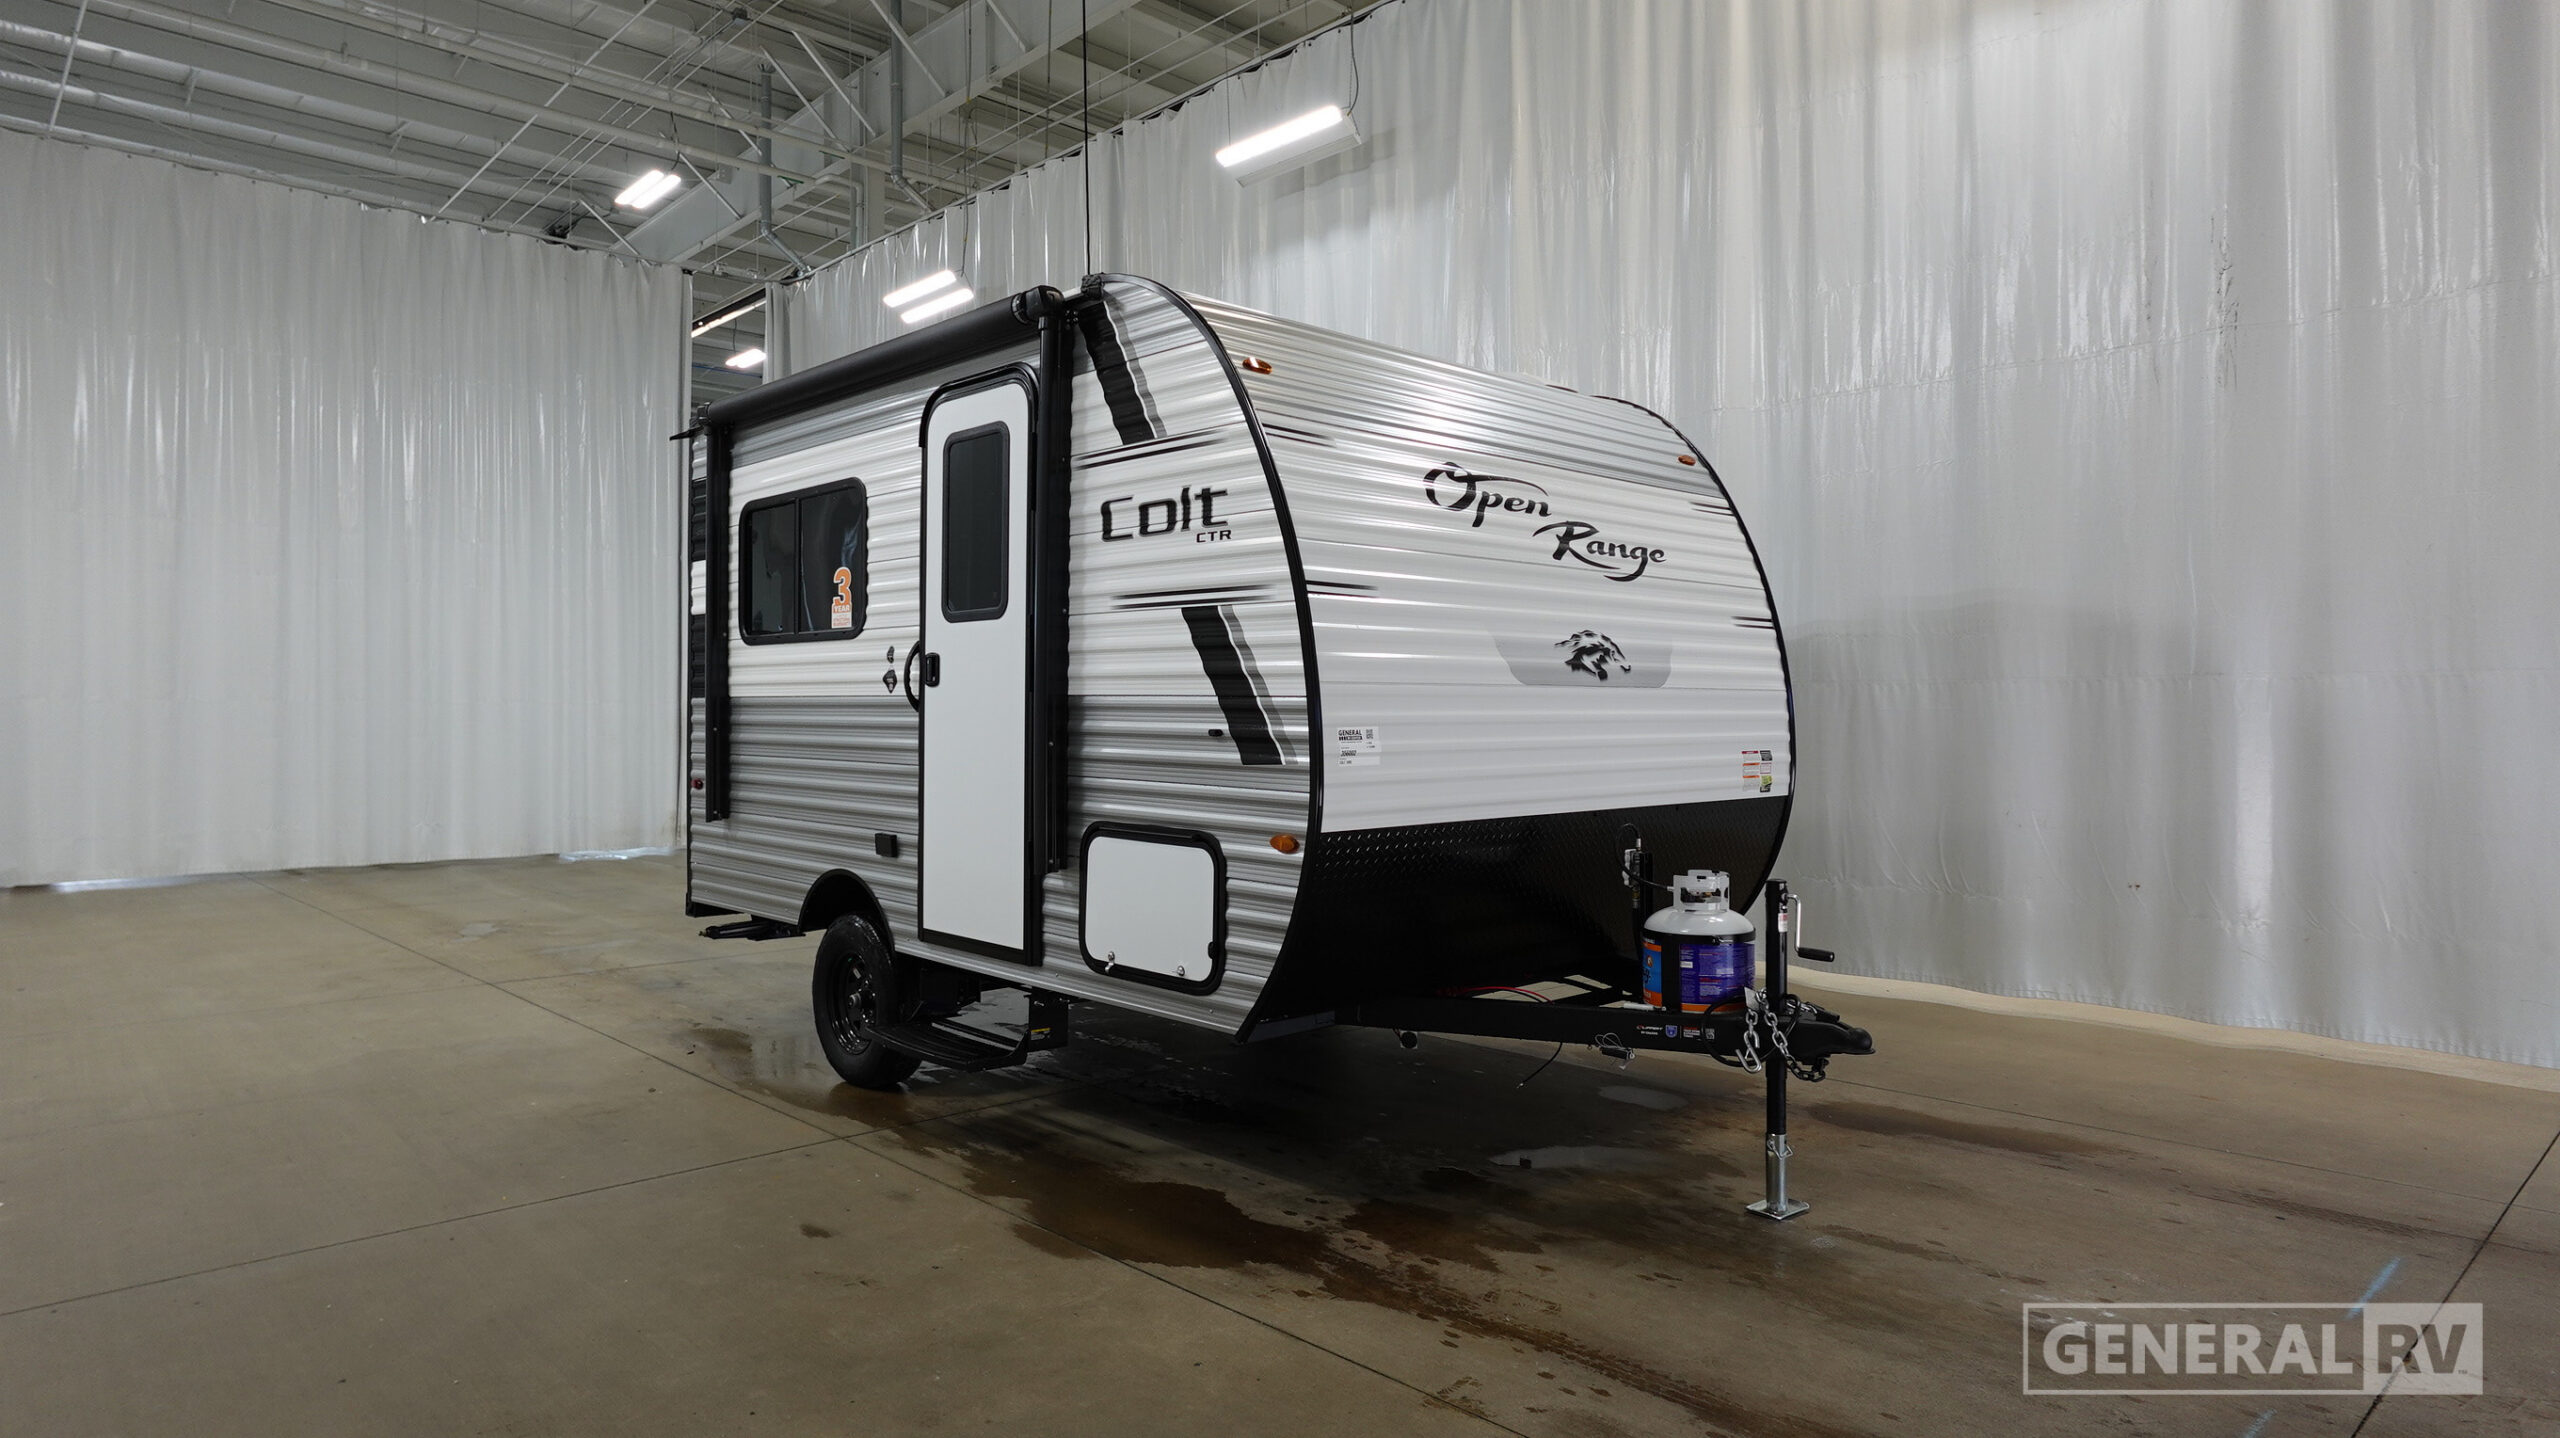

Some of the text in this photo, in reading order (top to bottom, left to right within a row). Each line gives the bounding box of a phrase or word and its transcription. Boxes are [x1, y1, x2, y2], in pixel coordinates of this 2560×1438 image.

[1101, 484, 1228, 542] Colt
[1423, 462, 1551, 527] Open
[1196, 529, 1232, 543] CTR
[1533, 521, 1667, 582] Range
[833, 567, 851, 605] 3
[834, 605, 850, 613] YEAR
